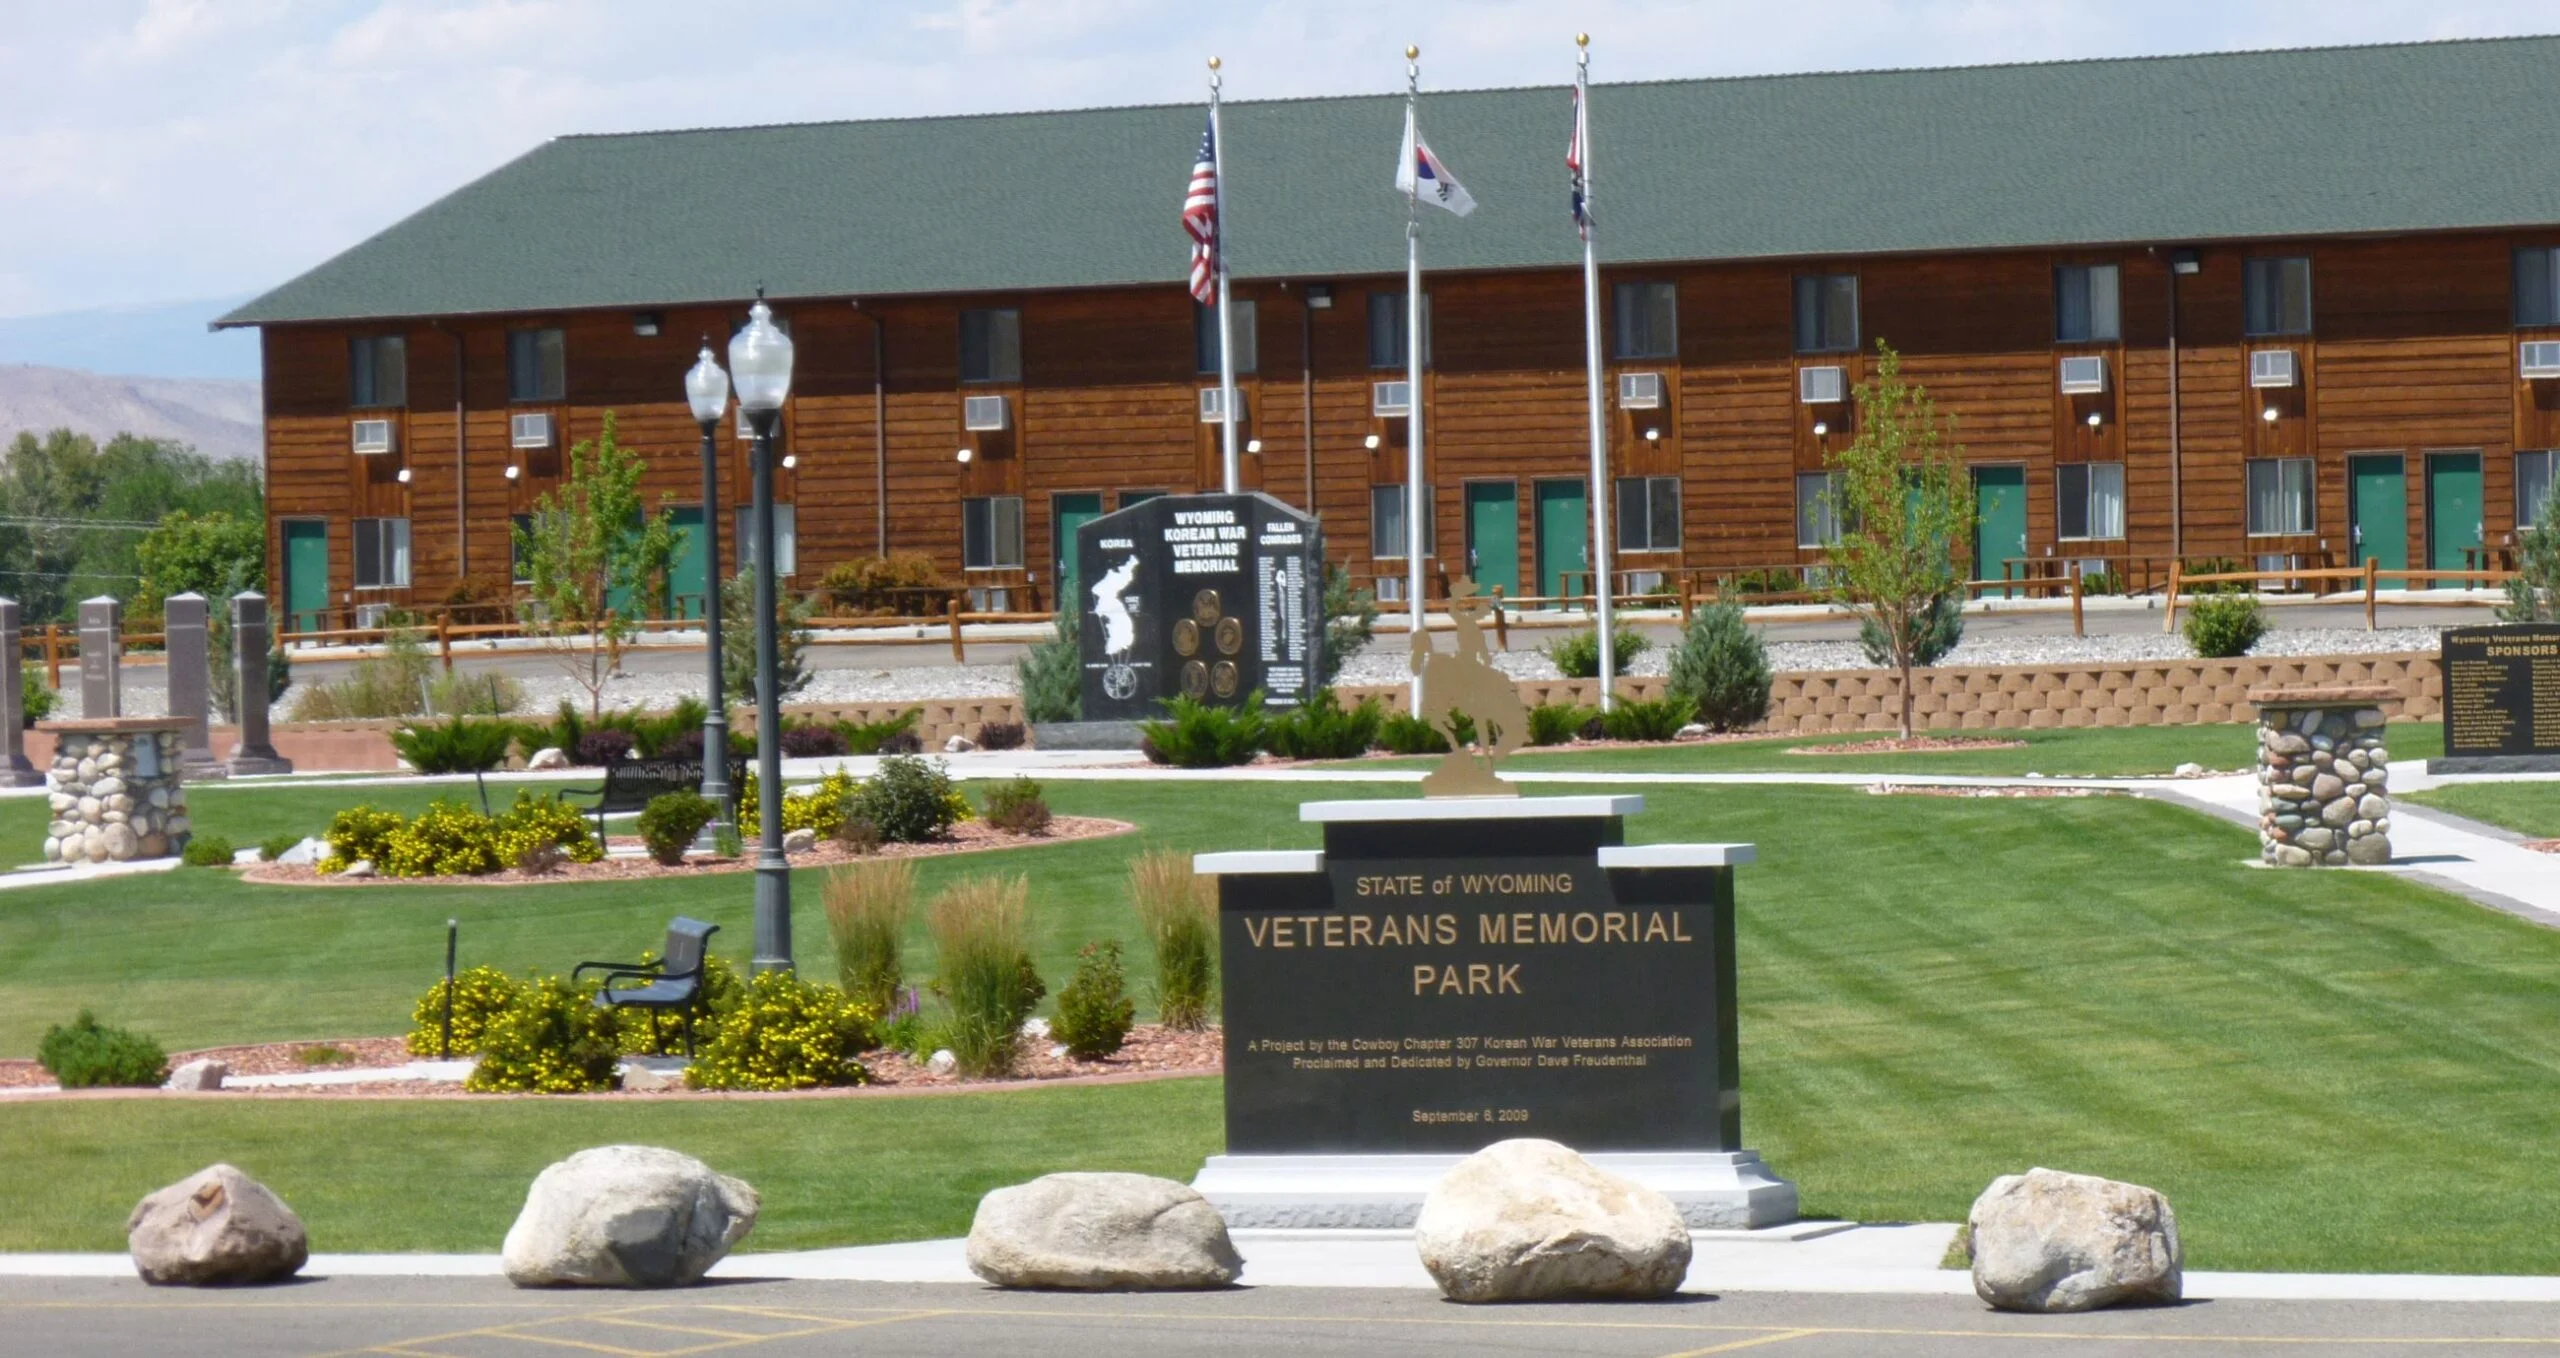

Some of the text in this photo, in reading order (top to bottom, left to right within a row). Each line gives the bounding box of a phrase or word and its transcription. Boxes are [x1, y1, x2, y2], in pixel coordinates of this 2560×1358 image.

[1174, 510, 1235, 525] WYOMING
[1164, 525, 1246, 542] KOREAN WAR
[1266, 522, 1295, 533] FALLEN
[1099, 539, 1135, 549] KOREA
[1260, 534, 1302, 545] COMRADES
[1172, 542, 1239, 558] VETERANS
[1174, 558, 1239, 574] MEMORIAL
[2451, 635, 2490, 644] Wyoming
[2492, 634, 2531, 643] Veterans
[2486, 645, 2558, 656] SPONSORS
[1356, 873, 1573, 896] STATE of WYOMING
[1244, 911, 1693, 948] VETERANS MEMORIAL
[1414, 963, 1522, 996] PARK
[1247, 1035, 1693, 1054] A Project by the Cowboy Chapter 307 Korean War Veterans Association
[1293, 1054, 1647, 1069] Proclaimed and Dedicated by Governor Dave Freudenthal
[1412, 1110, 1479, 1125] September
[1498, 1108, 1529, 1122] 2009
